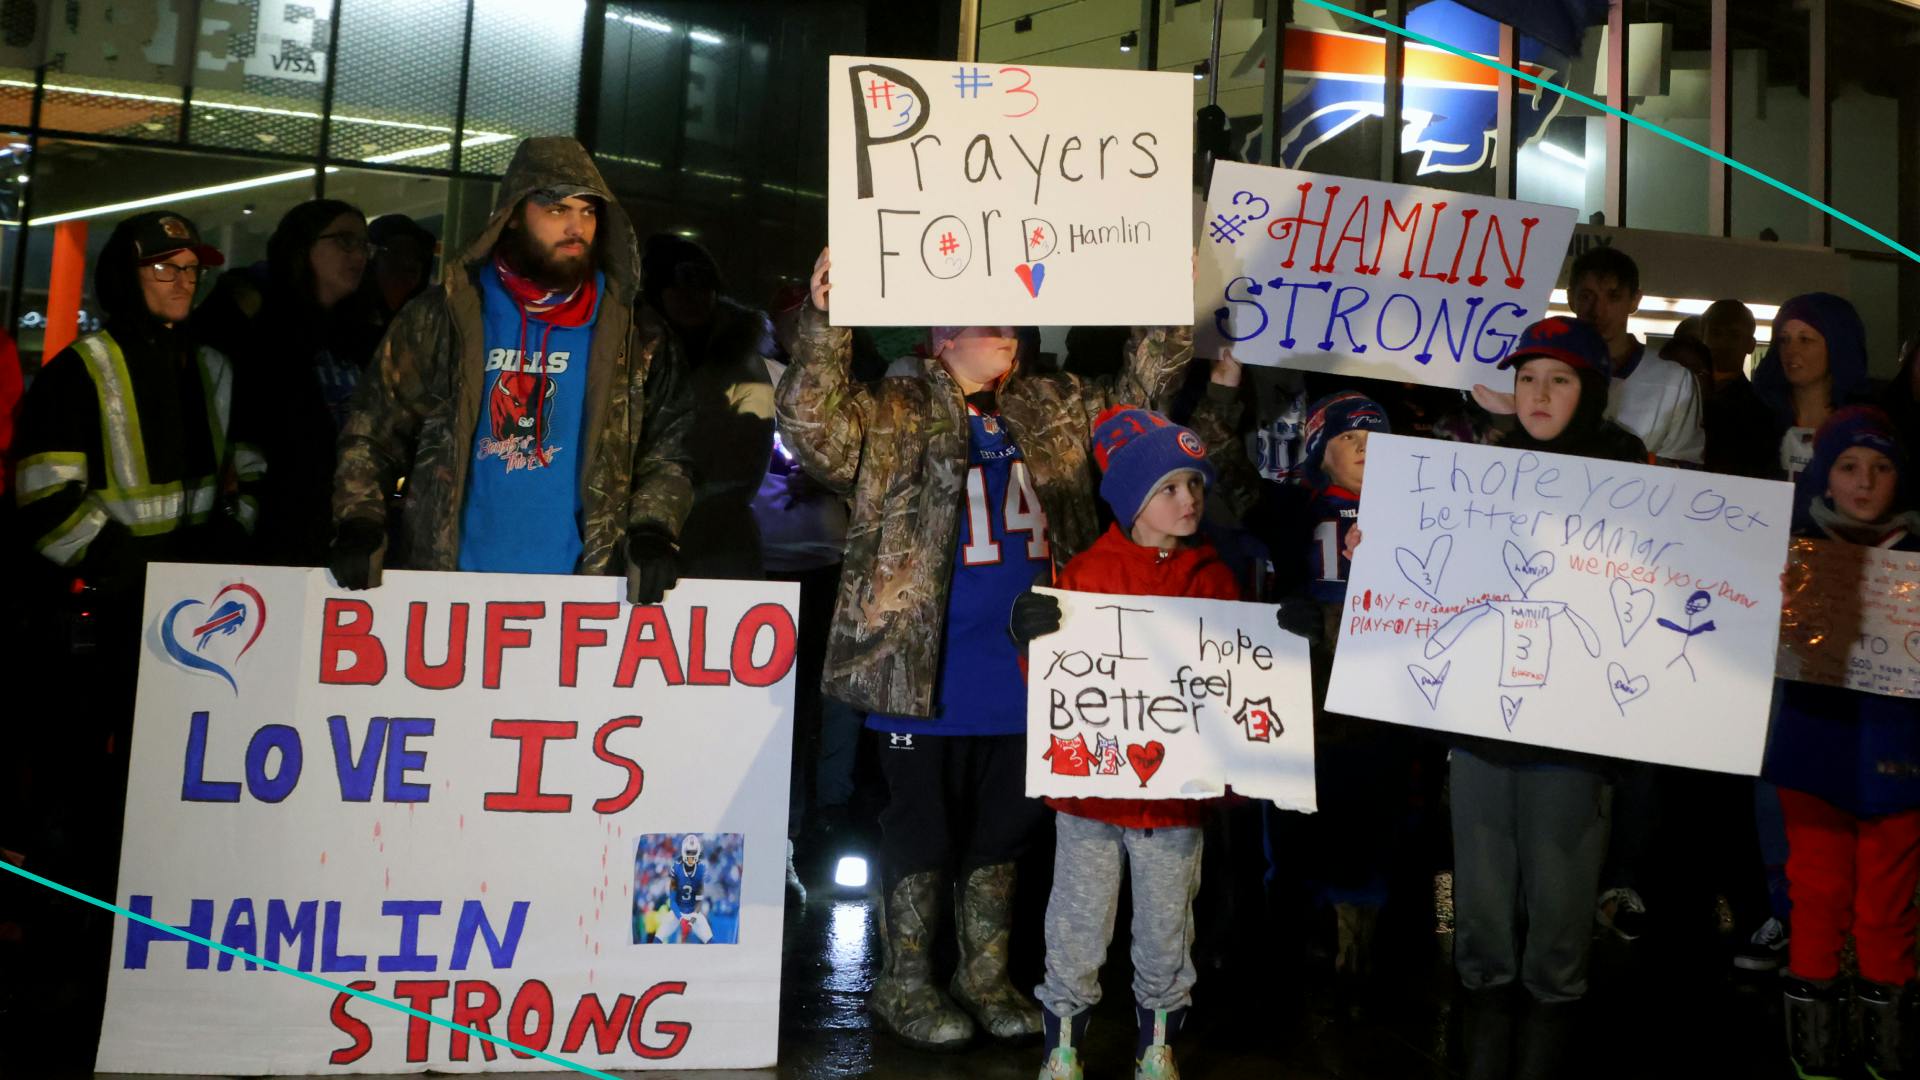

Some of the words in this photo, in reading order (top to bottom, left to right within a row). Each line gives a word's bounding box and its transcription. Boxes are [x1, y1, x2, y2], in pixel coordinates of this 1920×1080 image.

[270, 53, 317, 75] VISA
[848, 63, 1159, 205] Prayers
[1069, 215, 1151, 253] Hamlin
[1209, 190, 1270, 244] #3
[1267, 181, 1540, 289] HAMLIN
[1214, 276, 1528, 366] STRONG
[484, 348, 571, 374] BILLS
[1409, 454, 1435, 493] I
[963, 460, 1051, 566] 14
[1422, 572, 1432, 586] 3
[1095, 605, 1154, 660] I
[1199, 616, 1273, 670] hope
[1623, 601, 1633, 623] 3
[319, 598, 798, 688] BUFFALO
[1515, 634, 1532, 661] 3
[1170, 665, 1232, 707] feel
[181, 711, 436, 804] LOVE
[483, 715, 645, 814] IS
[681, 885, 693, 901] 3
[123, 894, 531, 973] HAMLIN
[329, 979, 694, 1066] STRONG
